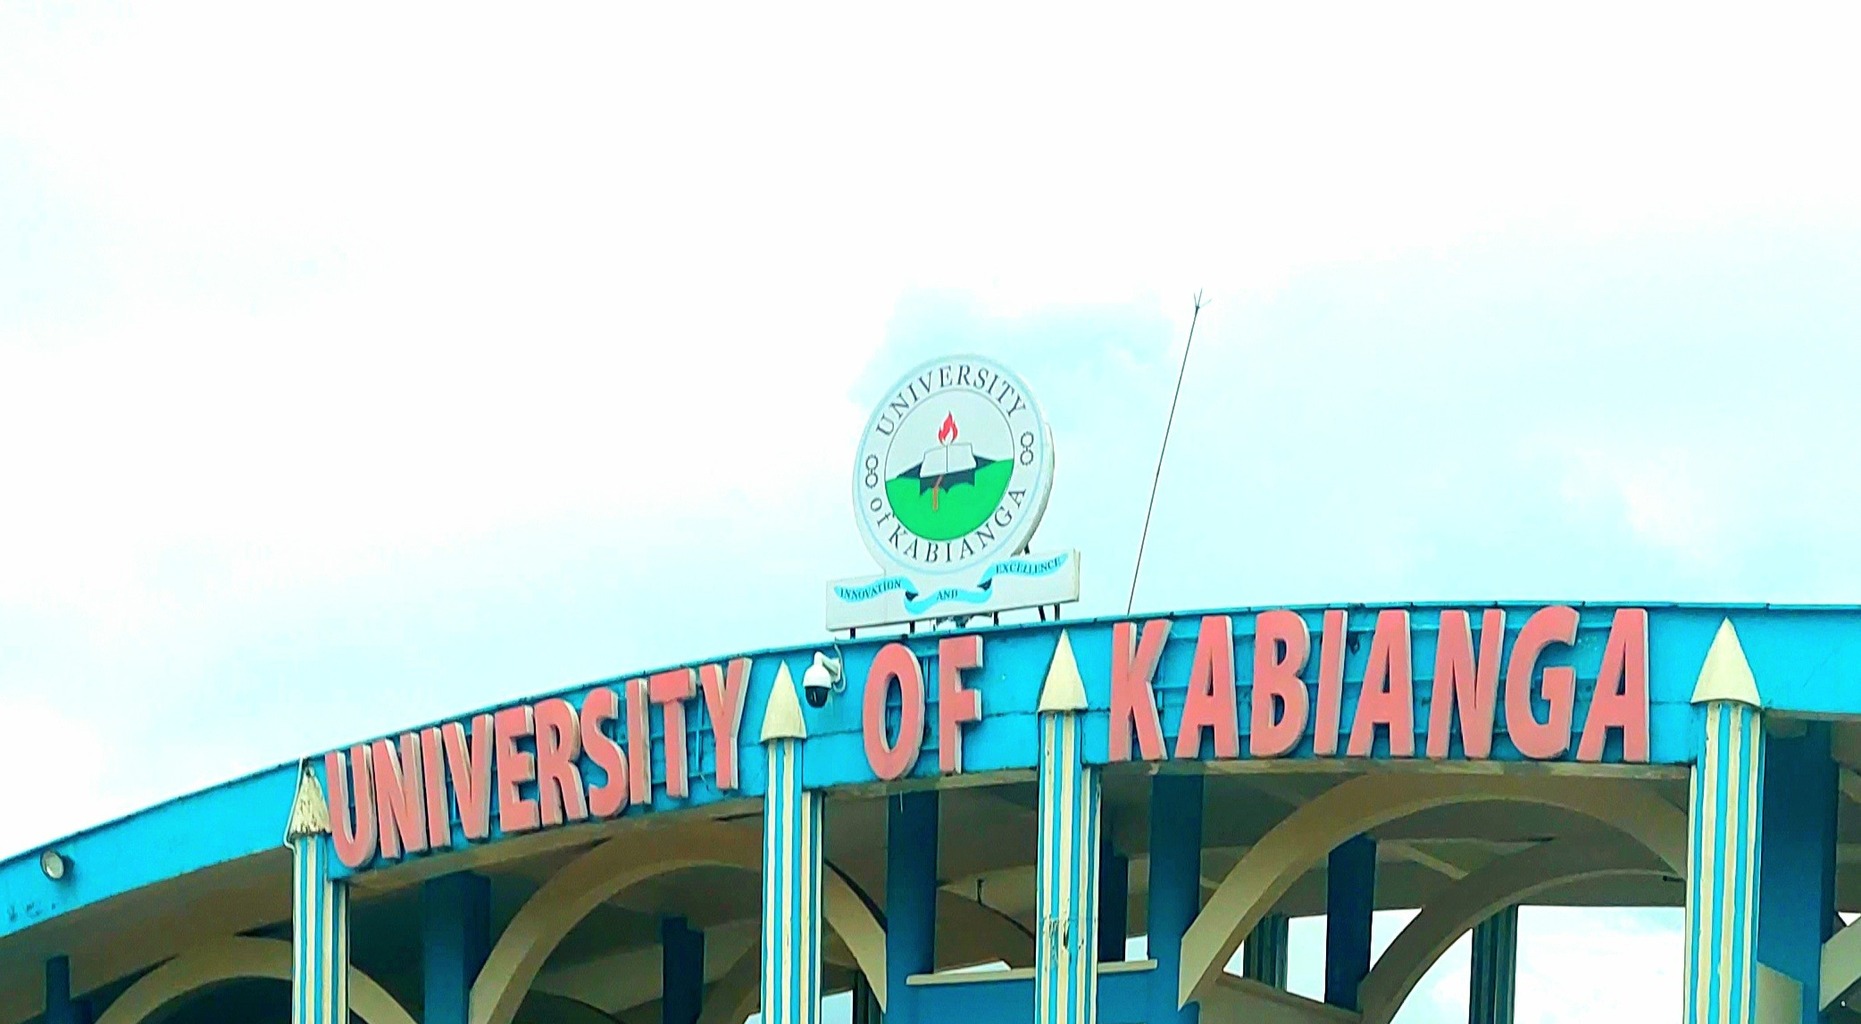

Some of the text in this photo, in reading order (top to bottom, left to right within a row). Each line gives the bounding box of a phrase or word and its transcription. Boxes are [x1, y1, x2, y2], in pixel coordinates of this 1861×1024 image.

[875, 363, 1027, 438] UNIVERSITY
[888, 487, 1027, 564] KABIANGA
[840, 557, 1062, 600] INNOVATION AND EXCELLENCE
[324, 605, 1650, 868] UNIVERSITY OF KABIANGA
